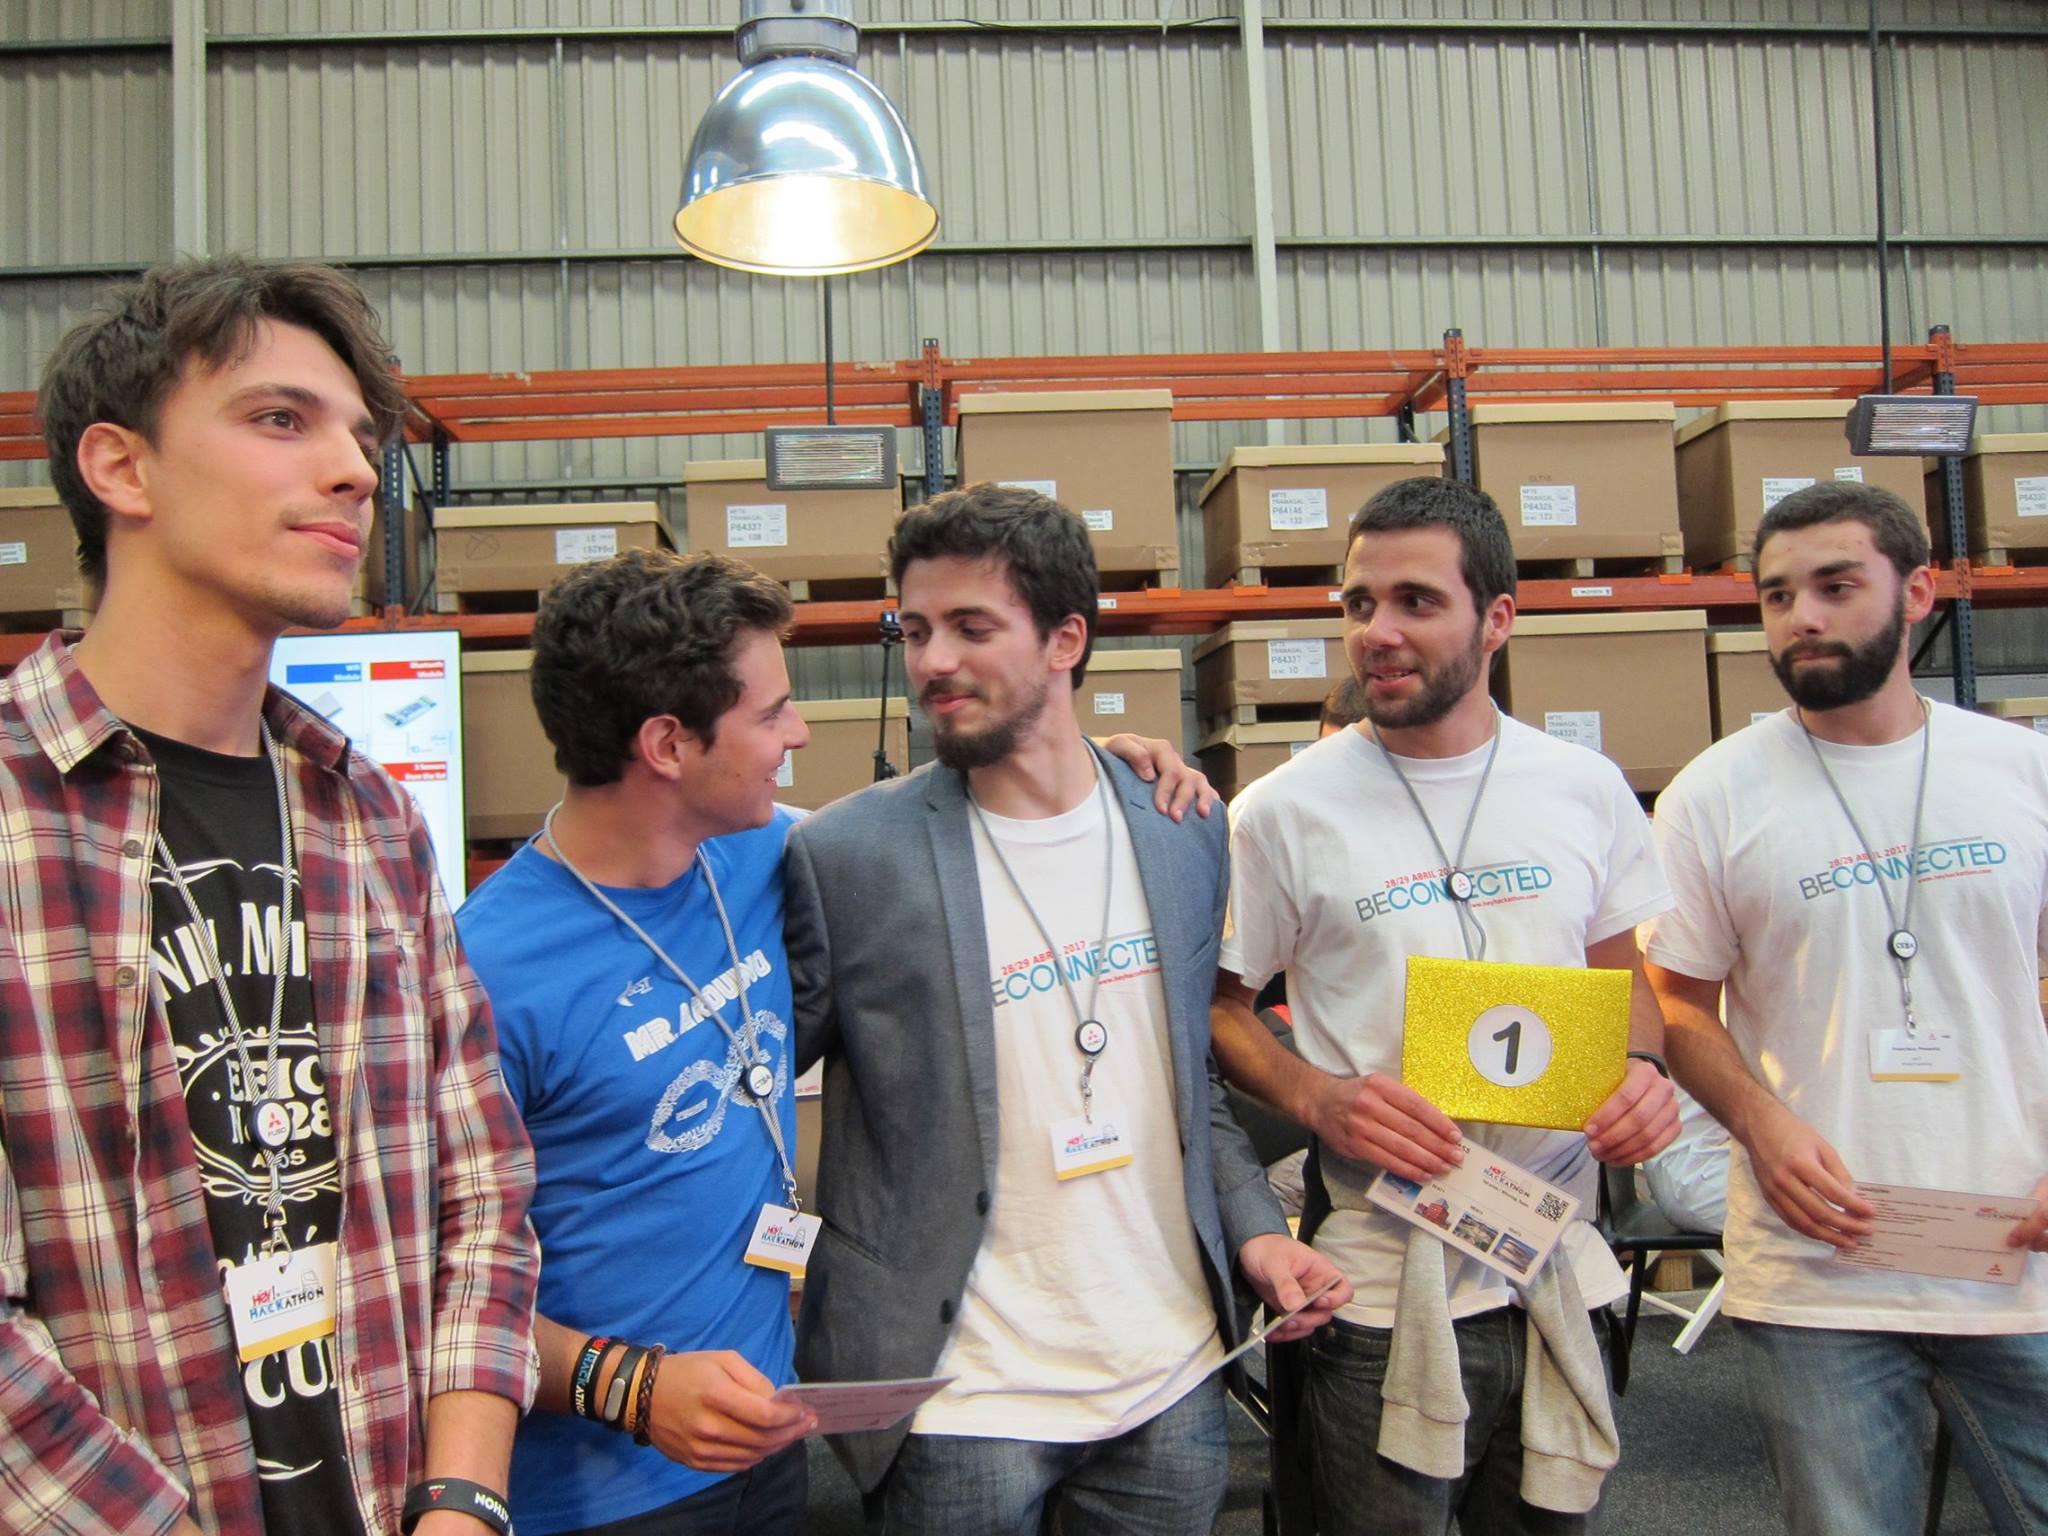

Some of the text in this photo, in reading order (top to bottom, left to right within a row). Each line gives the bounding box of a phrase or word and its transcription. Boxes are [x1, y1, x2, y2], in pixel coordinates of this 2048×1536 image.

[1798, 841, 2007, 901] BECONNECTED
[1856, 849, 1882, 862] ABIL
[1884, 845, 1907, 858] 2017
[1355, 866, 1553, 922] BECONECTED
[1385, 877, 1410, 889] 28/29
[1412, 871, 1437, 882] ABRIL
[992, 936, 1160, 1008] ECONNECTE
[1001, 960, 1030, 976] 28/29
[1062, 940, 1087, 955] 2017
[1492, 1020, 1522, 1075] 1
[252, 1148, 307, 1169] AOS
[1483, 1168, 1530, 1198] HACKATHON
[761, 1231, 806, 1250] HACKATHON
[248, 1286, 325, 1321] HACKATHON
